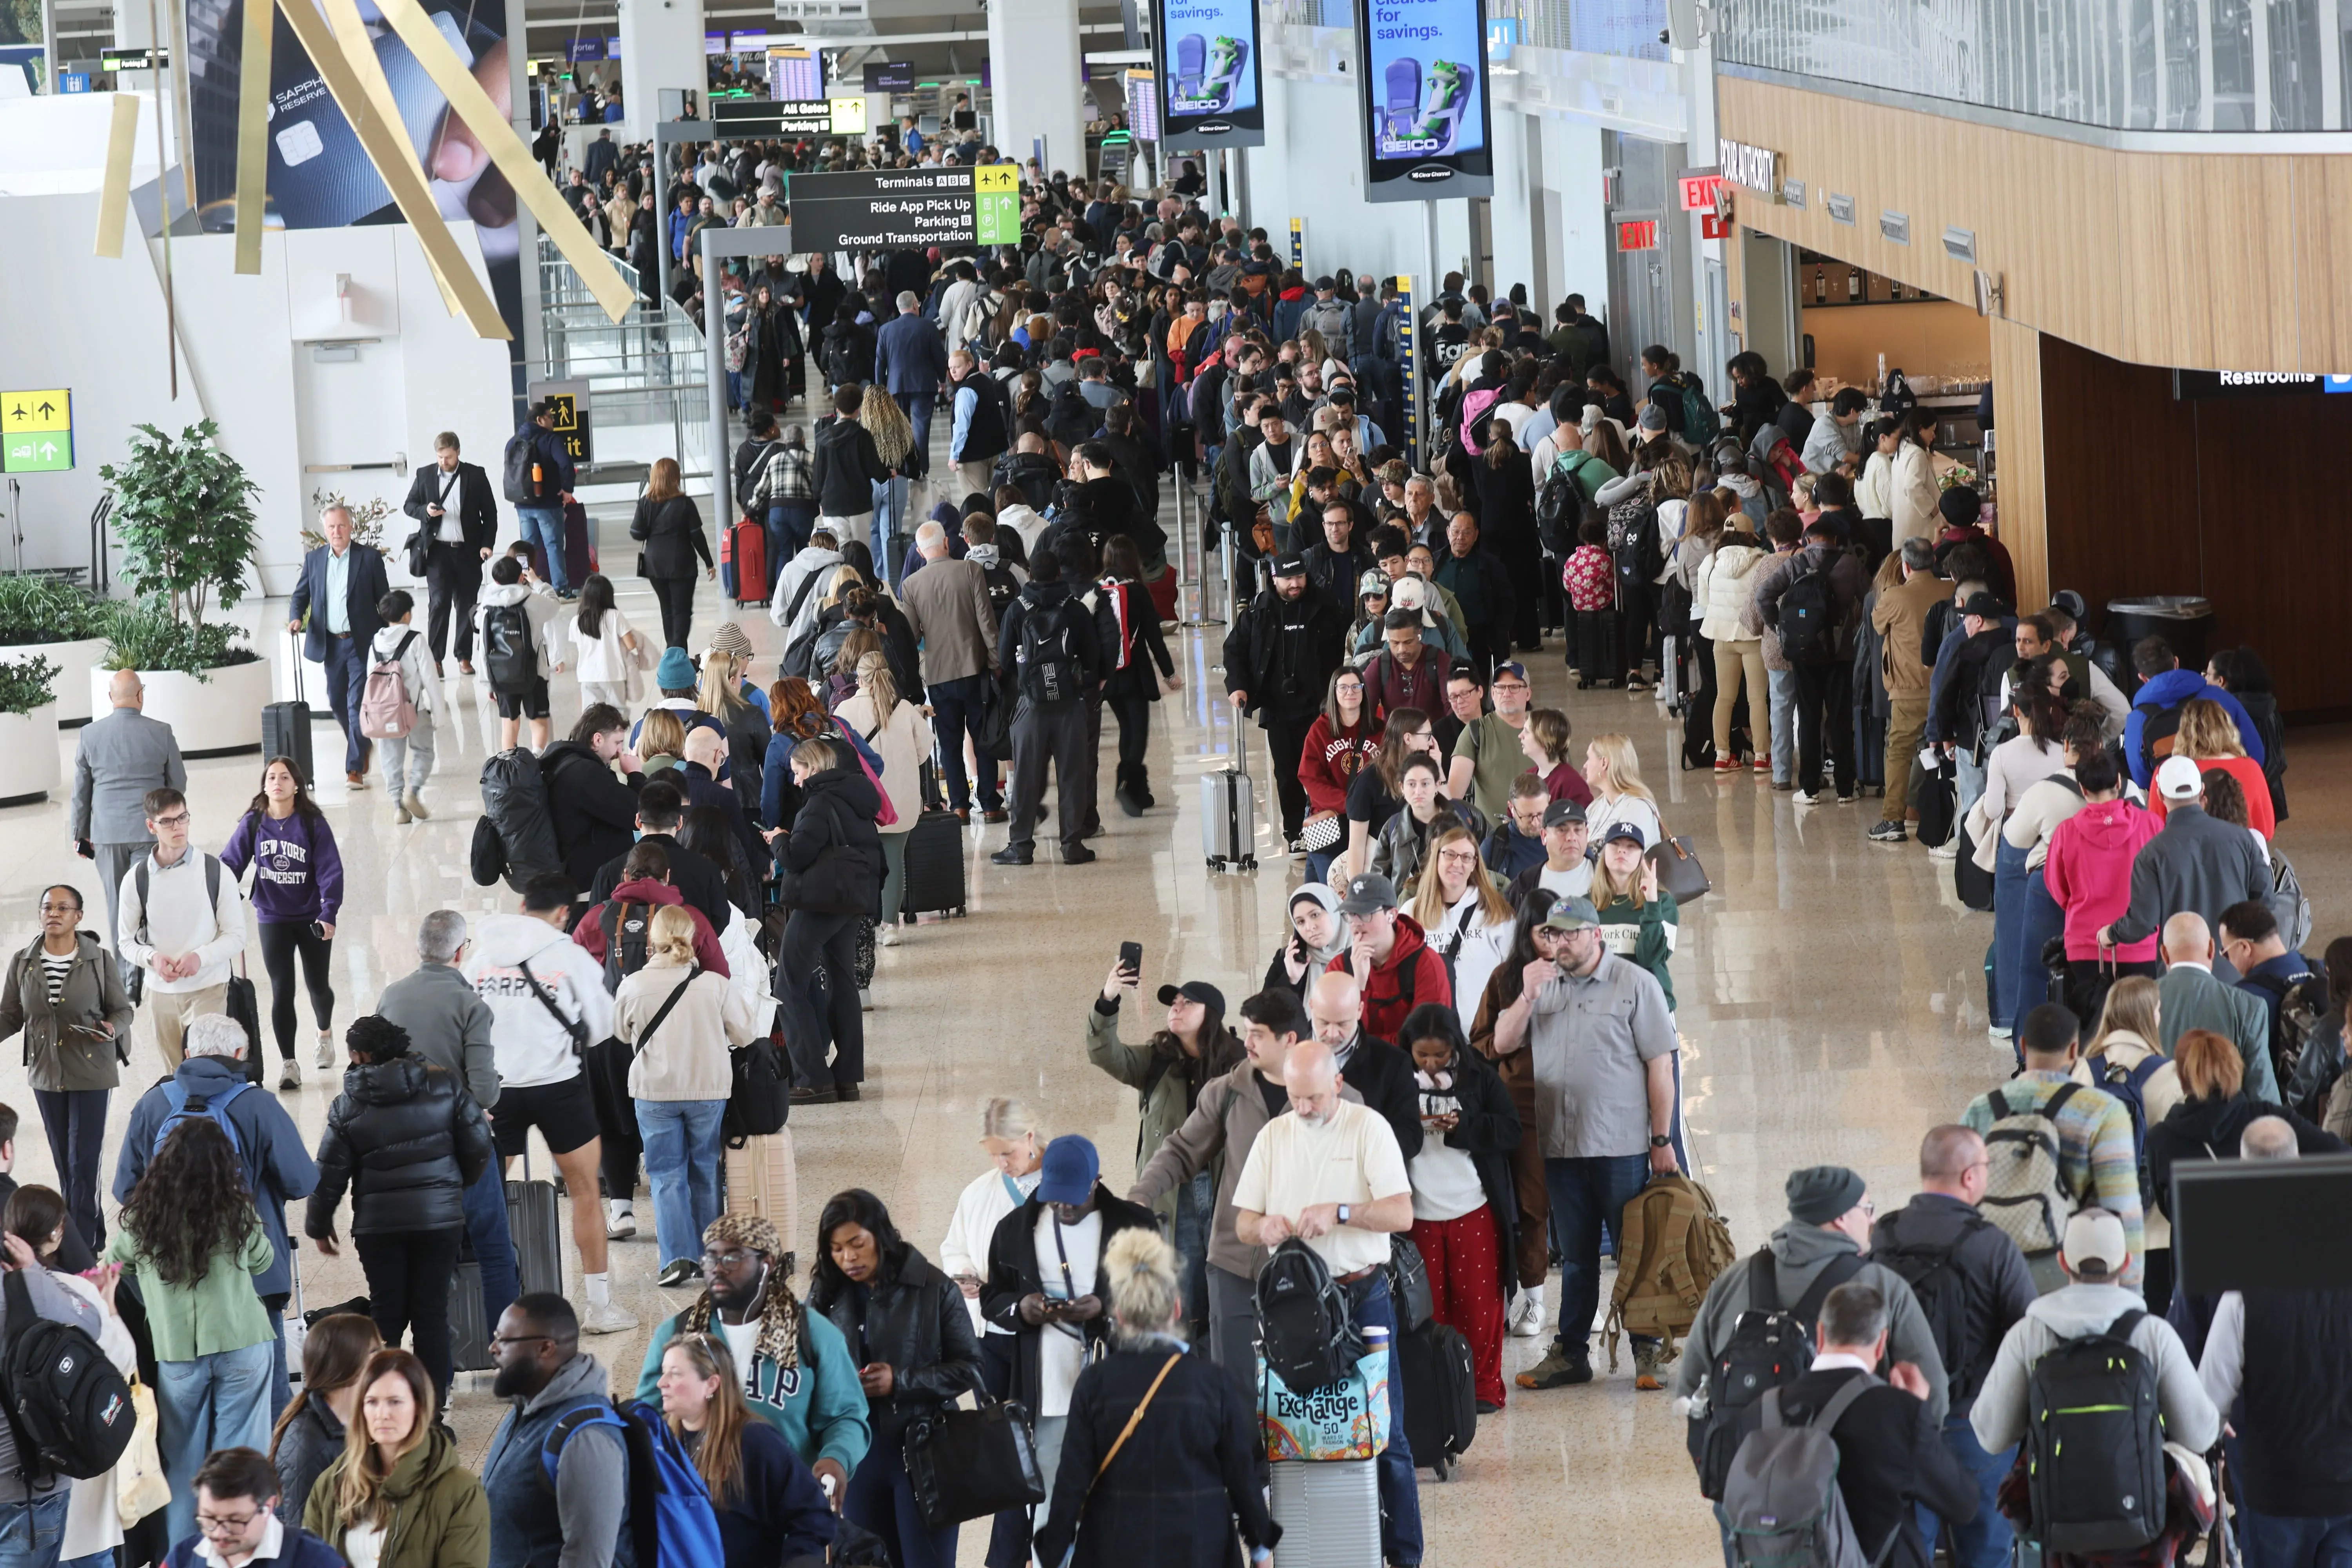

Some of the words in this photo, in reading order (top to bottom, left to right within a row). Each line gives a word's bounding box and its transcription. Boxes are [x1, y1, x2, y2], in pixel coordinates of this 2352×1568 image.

[1171, 6, 1223, 20] savings.
[1376, 8, 1401, 22] for
[1377, 24, 1443, 40] savings.
[276, 76, 323, 104] SAPPH
[280, 87, 327, 113] RESERVE
[1174, 99, 1220, 111] GEICO
[783, 103, 798, 114] All
[799, 103, 829, 114] Gates
[781, 121, 819, 133] Parking
[1382, 138, 1438, 152] GEICO
[1720, 138, 1738, 183] POUR
[1739, 143, 1773, 194] AUTHORITY
[875, 176, 933, 188] Terminals
[870, 202, 897, 213] Ride
[900, 201, 924, 214] App
[927, 200, 952, 211] Pick
[955, 199, 971, 211] Up
[915, 216, 959, 228] Parking
[838, 233, 883, 245] Ground
[886, 230, 973, 244] Transportation
[1622, 221, 1655, 249] EXIT
[2220, 370, 2316, 385] Restrooms
[567, 436, 582, 456] it
[1282, 561, 1300, 569] Supreme
[1621, 823, 1633, 834] NY
[280, 840, 306, 863] YORK
[1426, 933, 1444, 944] EW
[746, 1353, 802, 1410] AP
[1274, 1392, 1358, 1425] Exchange
[1324, 1423, 1338, 1434] 50
